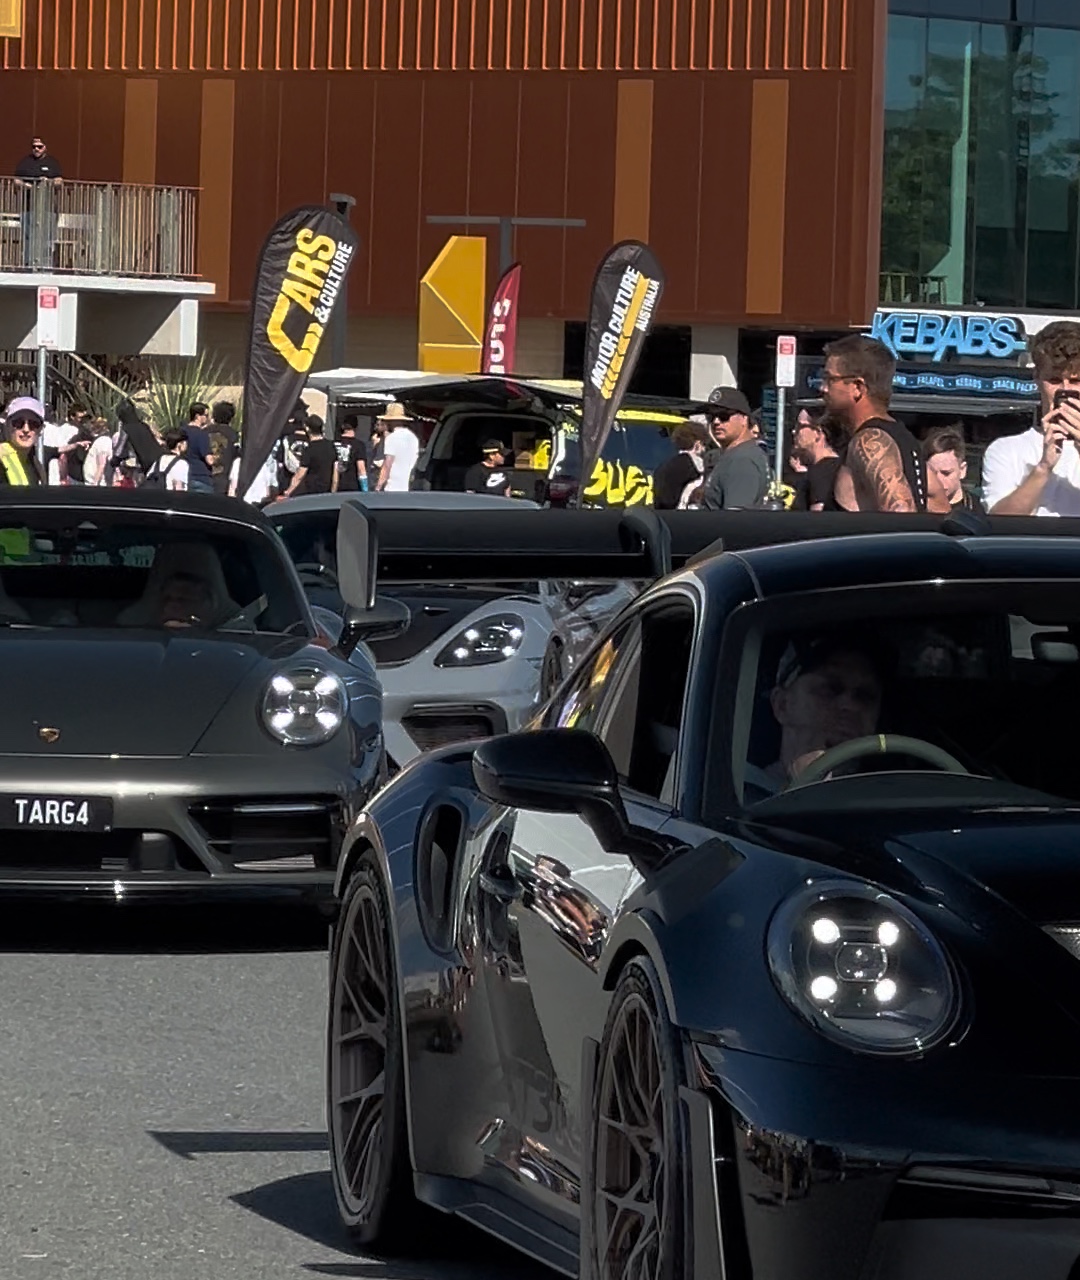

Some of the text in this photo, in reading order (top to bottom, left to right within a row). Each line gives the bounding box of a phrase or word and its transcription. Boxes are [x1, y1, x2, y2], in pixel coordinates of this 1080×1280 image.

[267, 228, 337, 372] CARS
[635, 279, 660, 332] AUSTRALIA
[591, 265, 640, 390] MOTOR CULTURE
[871, 312, 1026, 362] KEBABS
[15, 799, 88, 825] TARG4
